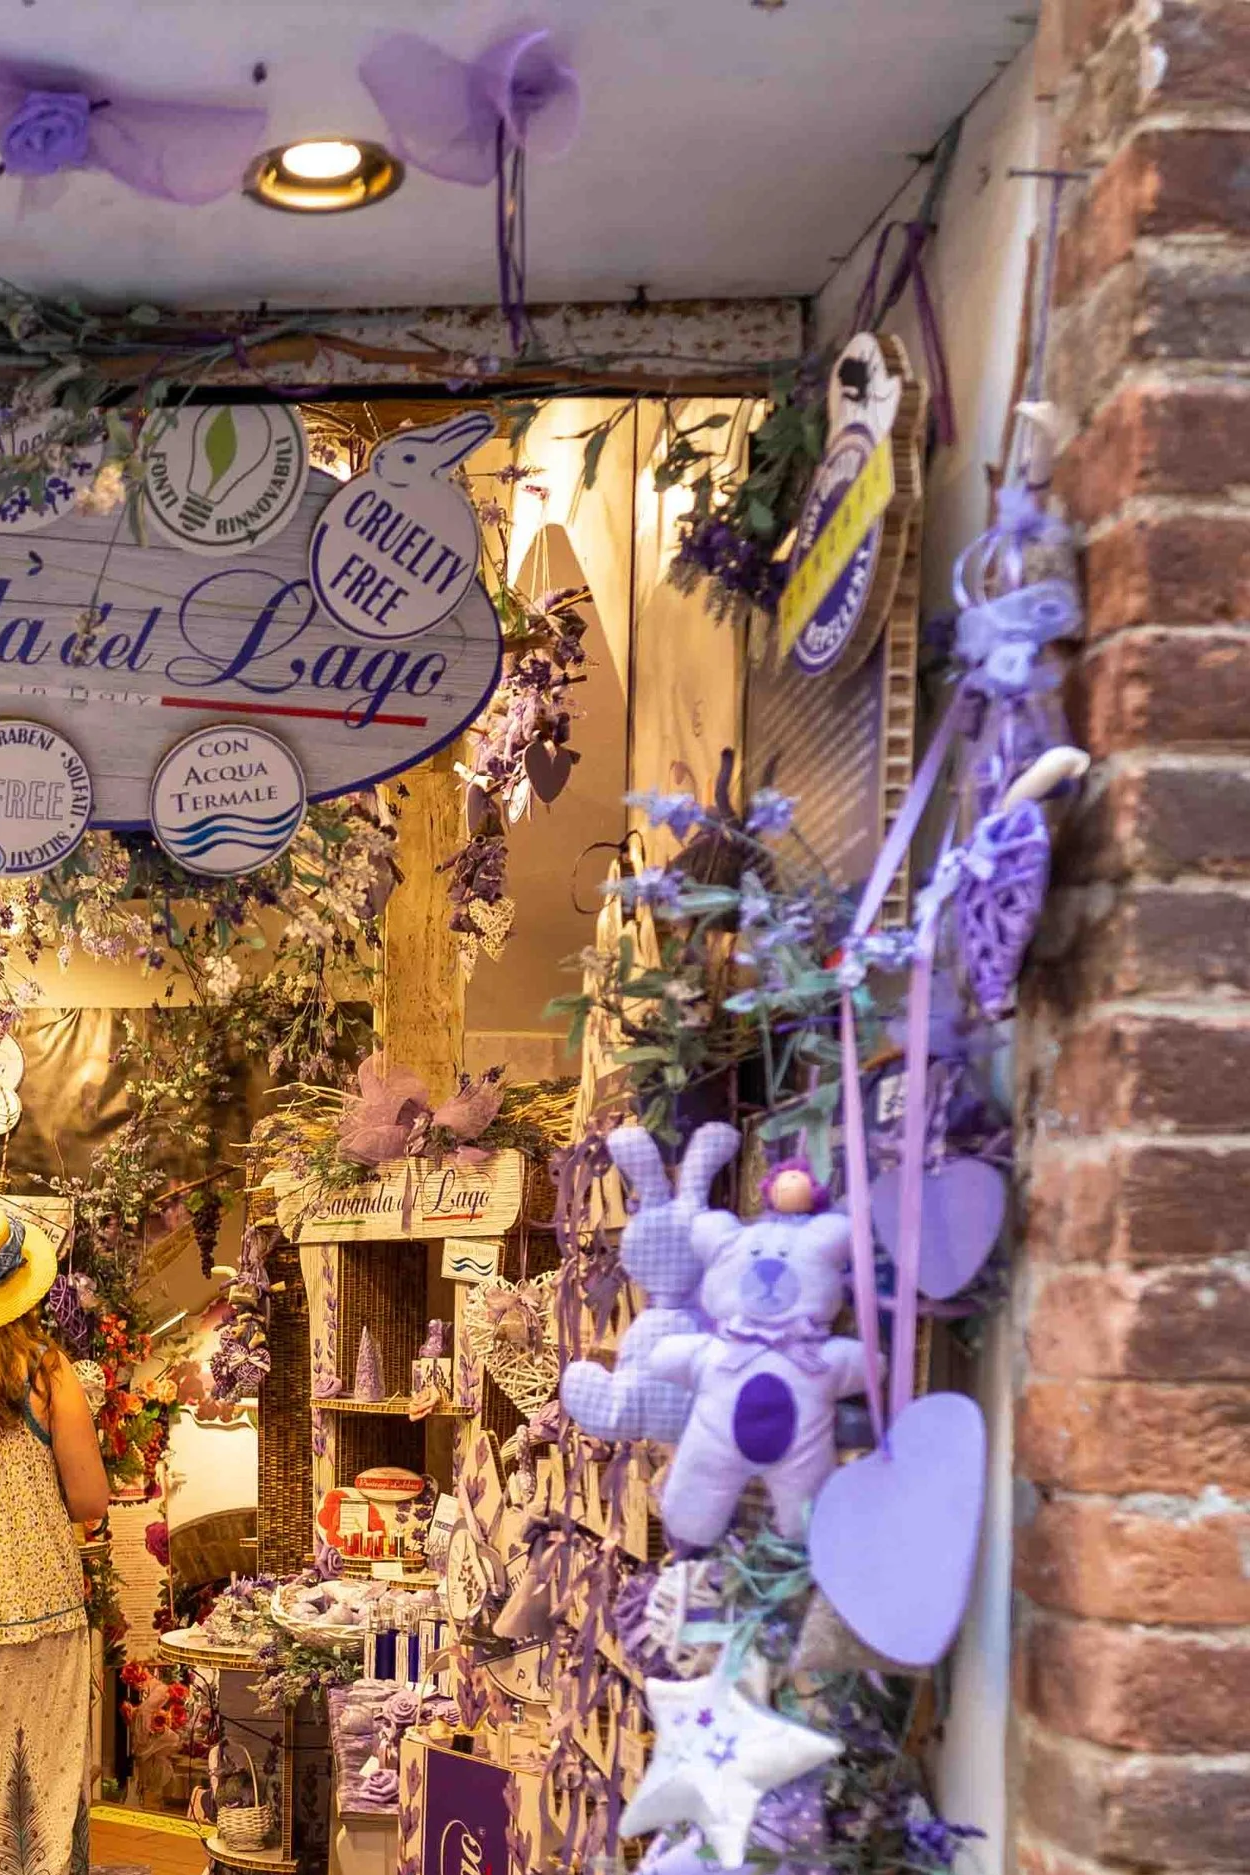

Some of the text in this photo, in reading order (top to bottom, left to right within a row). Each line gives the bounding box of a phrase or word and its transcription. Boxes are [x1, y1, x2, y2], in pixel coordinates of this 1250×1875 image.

[149, 436, 293, 536] FONTI RINNOVABILI
[344, 488, 471, 597] CRUELTY
[330, 553, 410, 628] FREE
[60, 601, 163, 673] del
[165, 568, 449, 730] Lago
[182, 760, 268, 787] ACQUA
[197, 736, 250, 757] CON
[63, 755, 90, 817] SOLFATI
[170, 784, 279, 815] TERMALE
[10, 830, 72, 867] SILICATI
[303, 1183, 394, 1220] Lavanda
[421, 1168, 492, 1223] Lago
